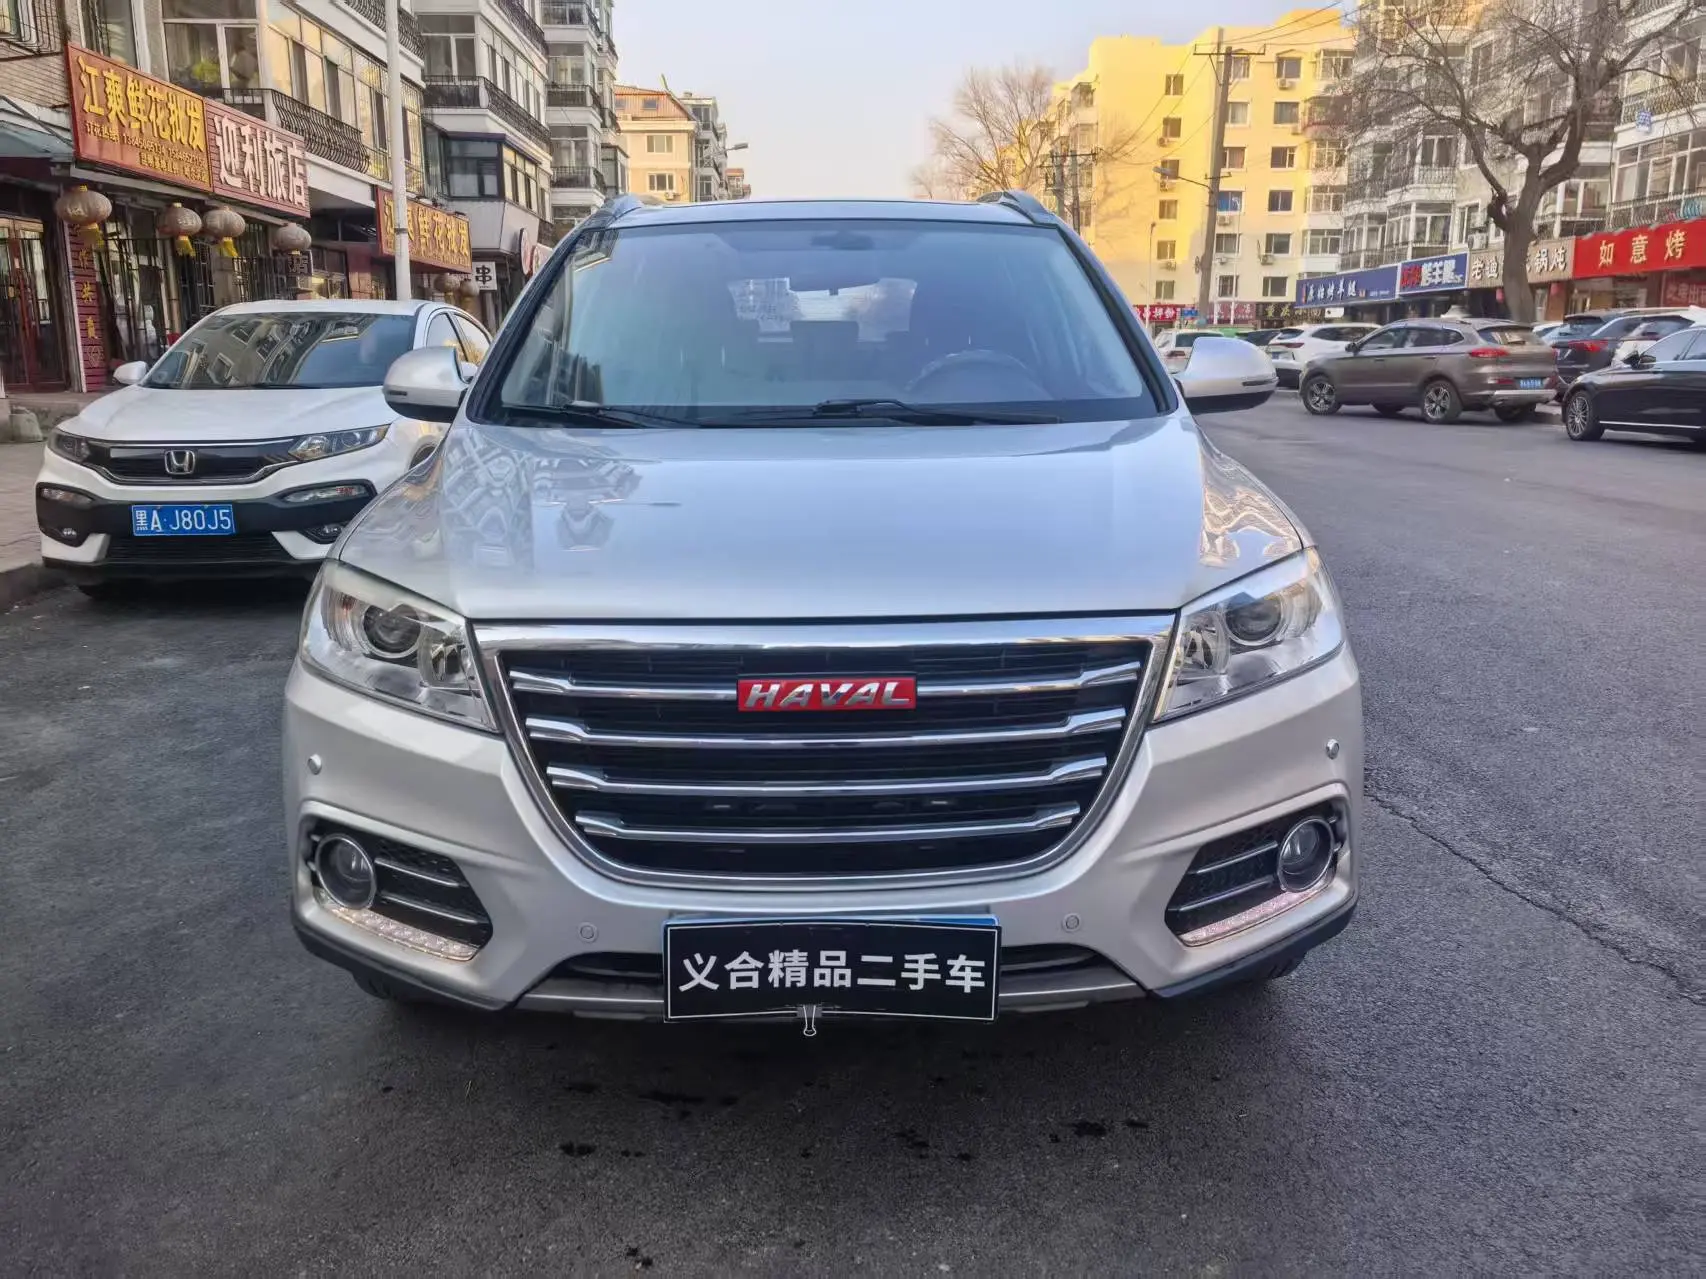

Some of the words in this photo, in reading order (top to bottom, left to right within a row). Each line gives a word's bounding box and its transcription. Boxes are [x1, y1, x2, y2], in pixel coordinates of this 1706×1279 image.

[214, 115, 306, 207] 迎利旅店
[1599, 229, 1686, 270] 如意烤
[475, 264, 492, 285] 串
[745, 681, 910, 708] HAVAL
[679, 949, 986, 993] 义合精品二手车
